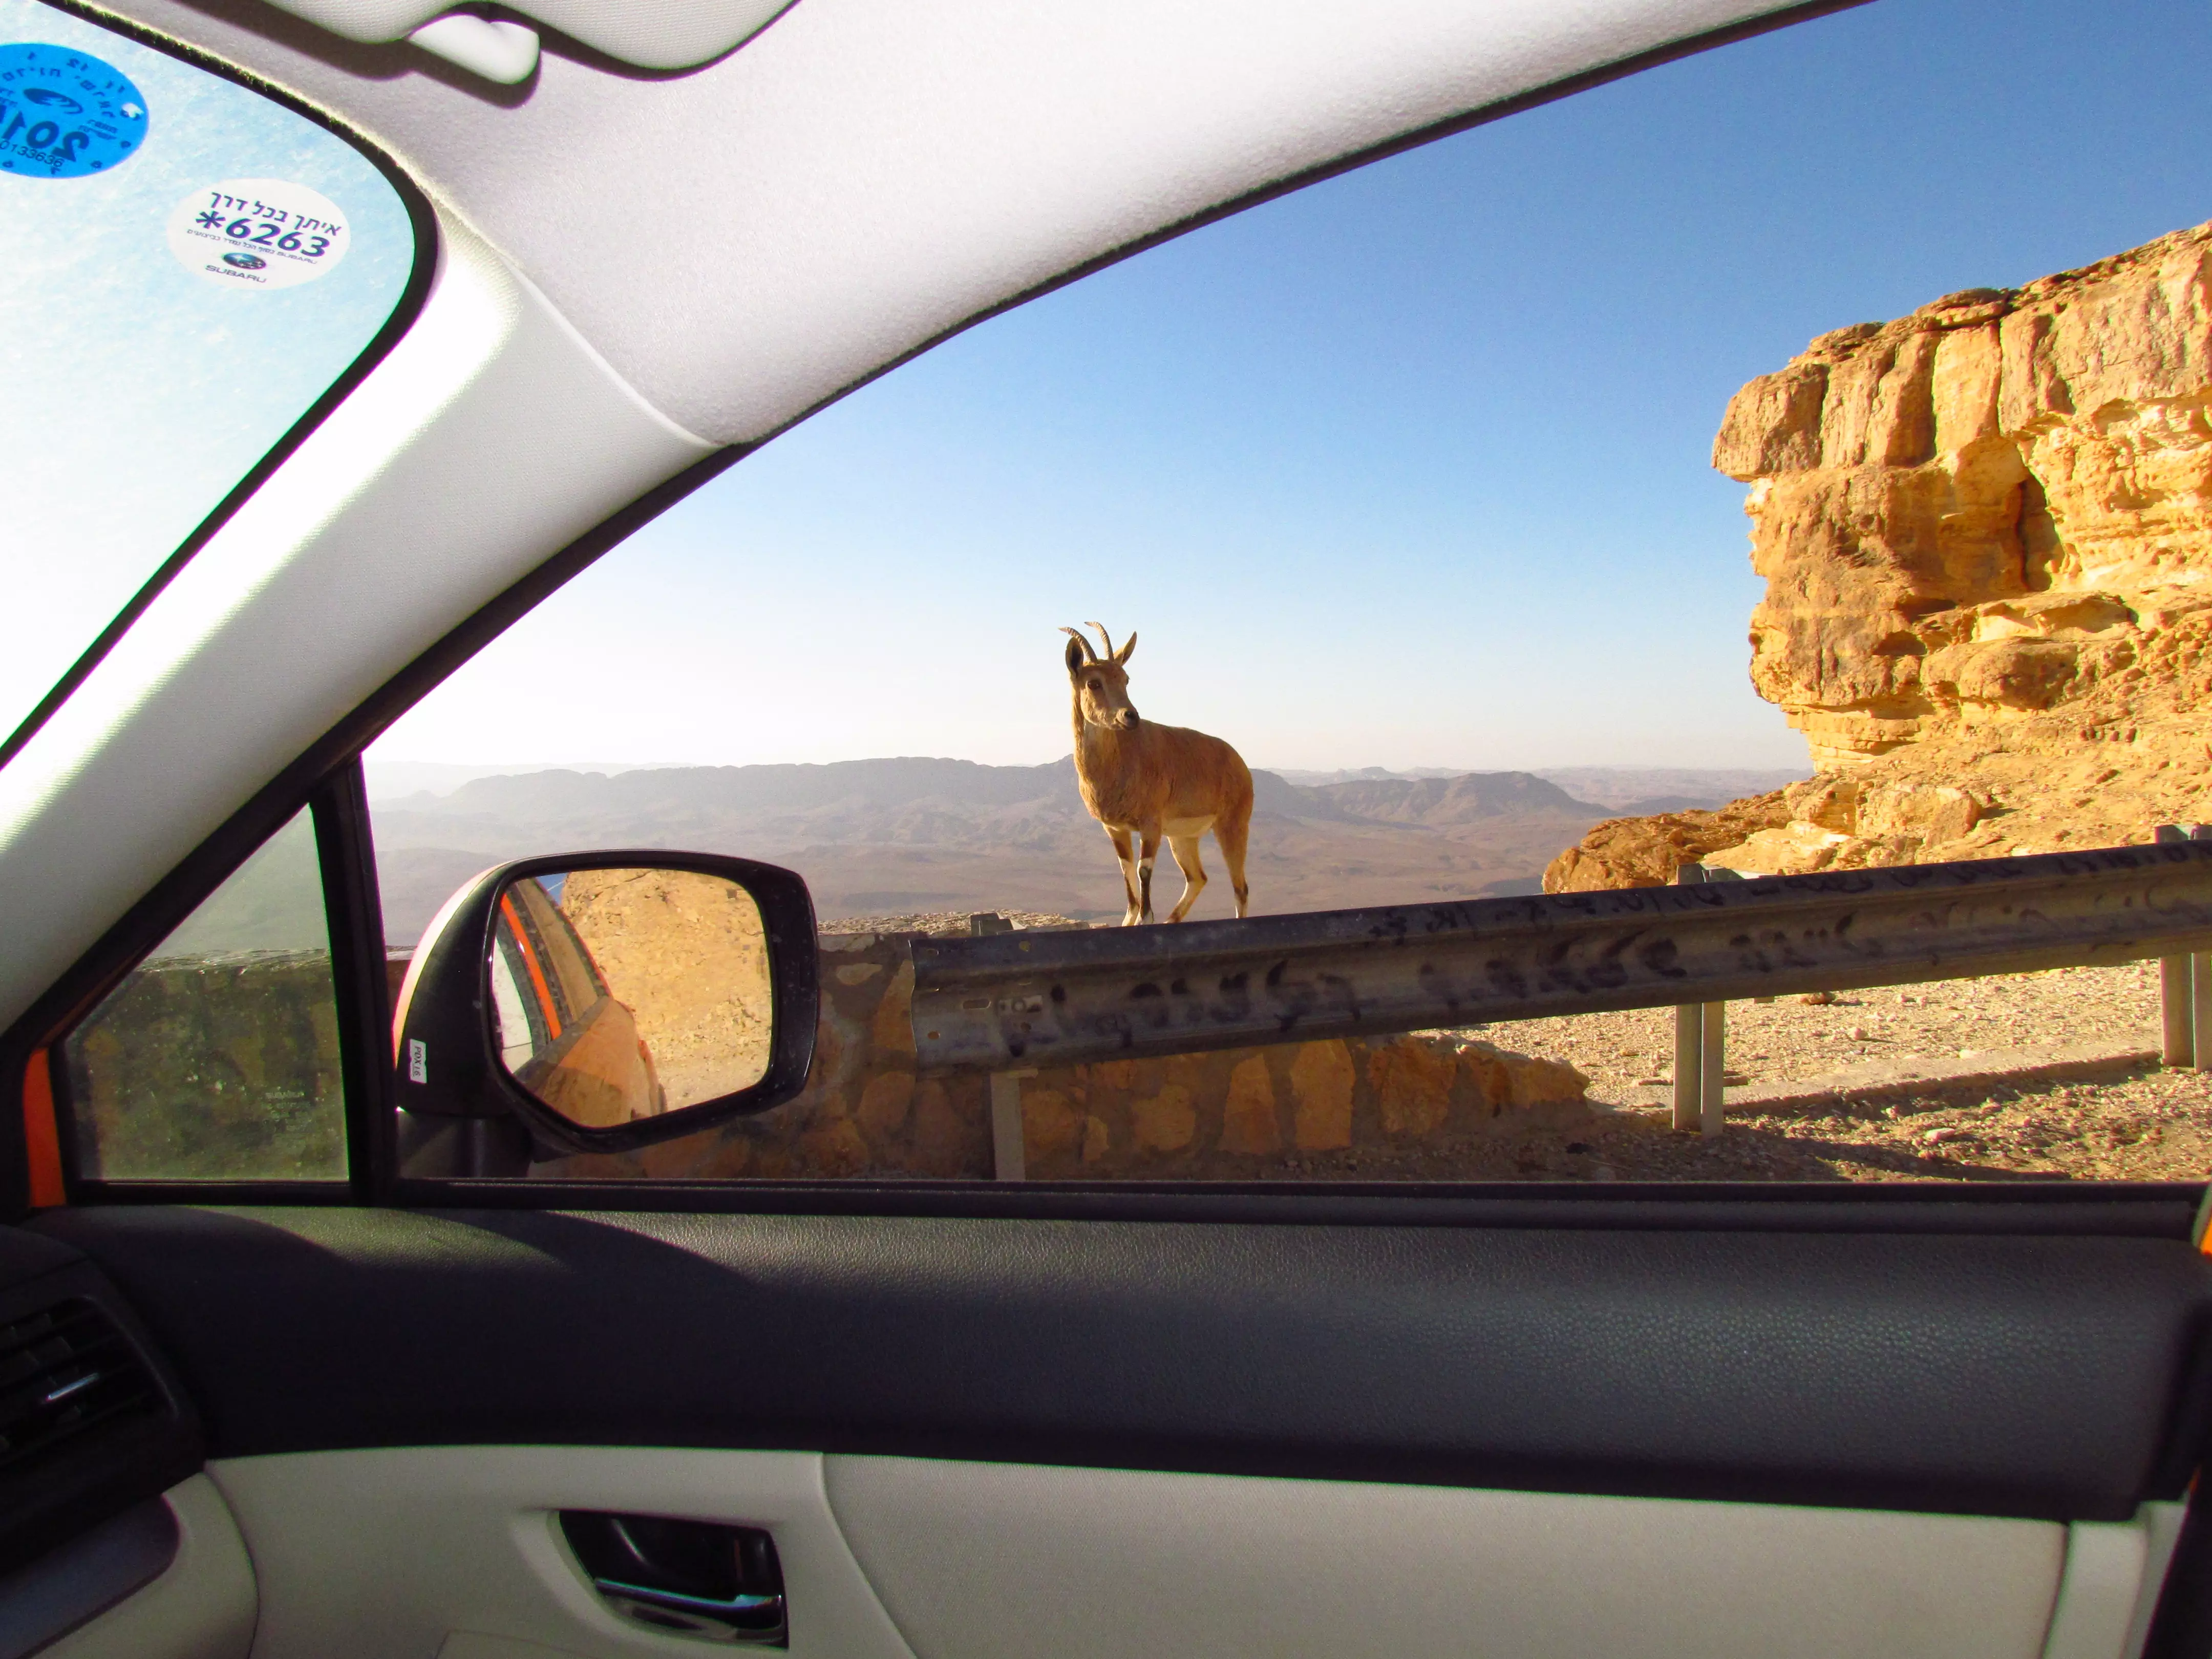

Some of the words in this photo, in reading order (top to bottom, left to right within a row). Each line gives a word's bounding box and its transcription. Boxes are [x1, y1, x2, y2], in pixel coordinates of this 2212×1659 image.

[211, 192, 248, 211] דרך
[252, 201, 288, 222] בכל
[294, 215, 342, 236] איתך
[205, 265, 267, 283] SUBARU
